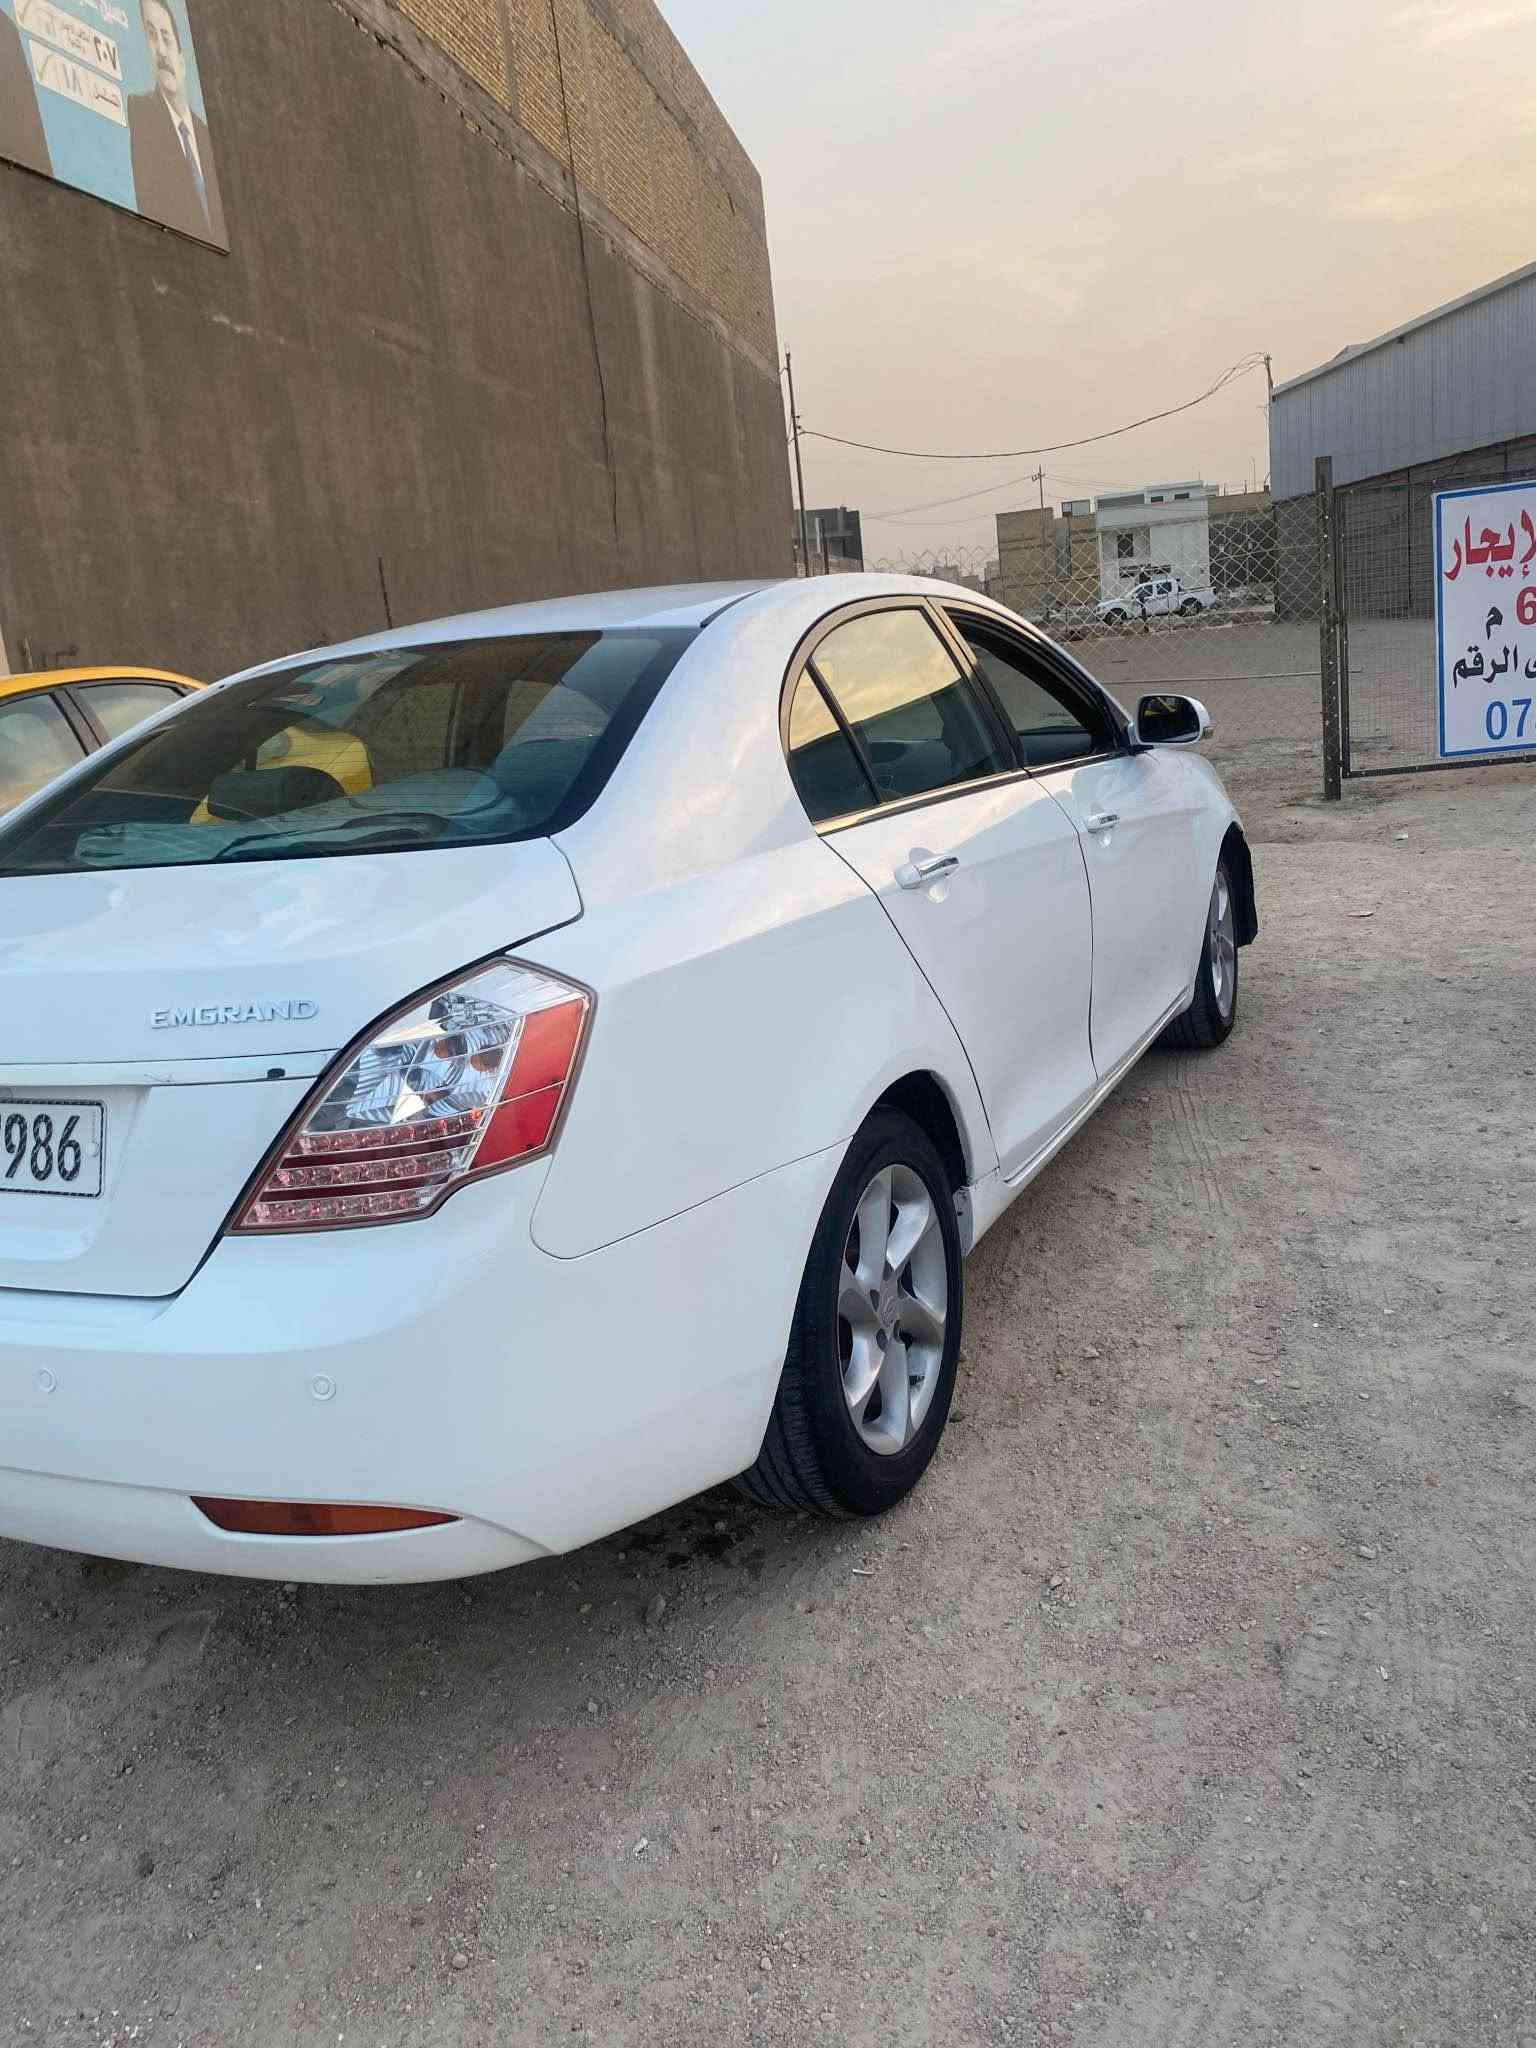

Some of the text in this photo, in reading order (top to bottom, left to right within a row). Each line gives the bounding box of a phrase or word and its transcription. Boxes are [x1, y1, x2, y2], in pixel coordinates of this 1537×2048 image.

[1453, 644, 1518, 688] الرقم
[150, 1000, 319, 1029] EMGRAND
[0, 1111, 81, 1181] 986
